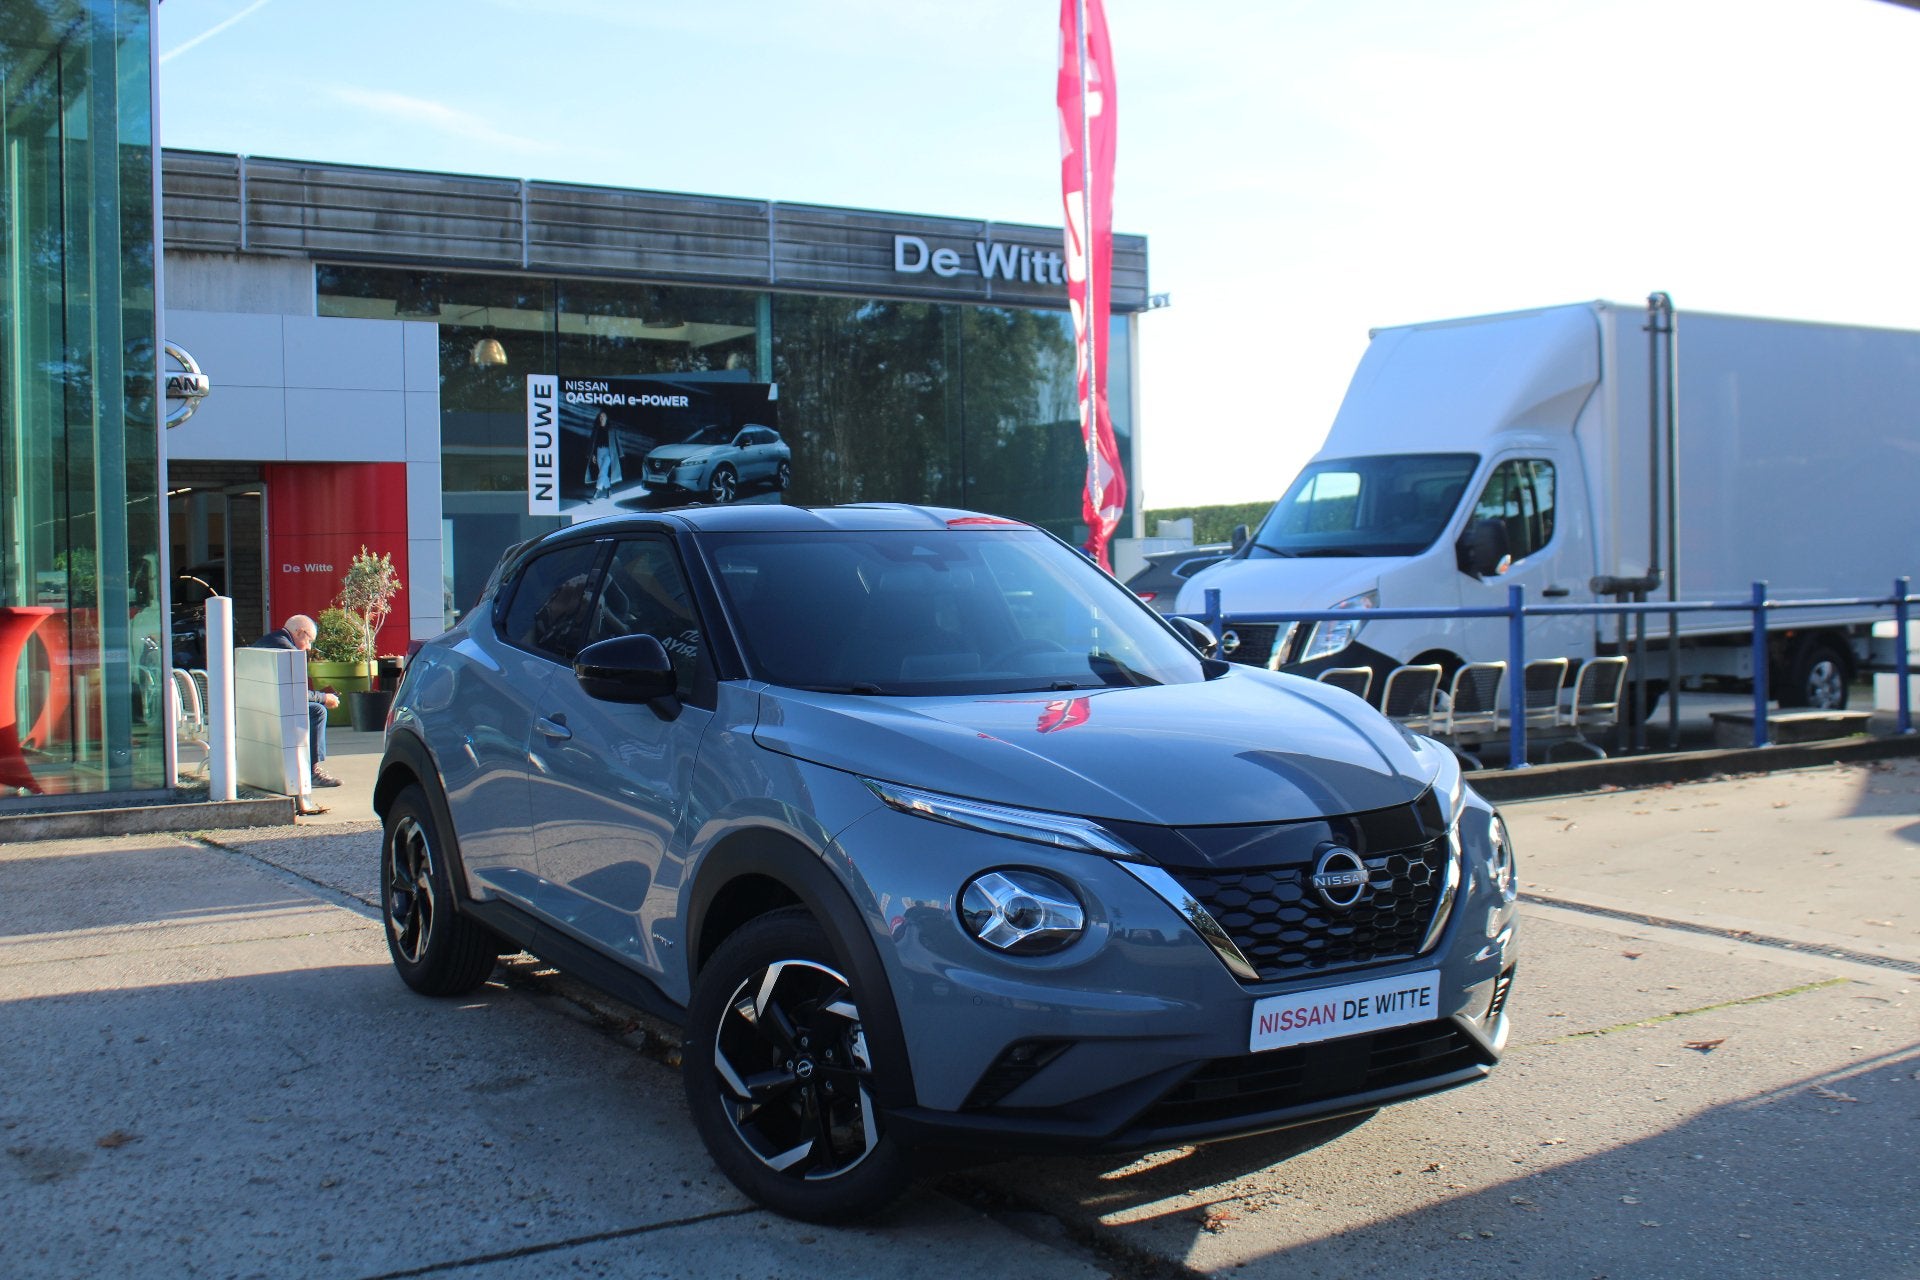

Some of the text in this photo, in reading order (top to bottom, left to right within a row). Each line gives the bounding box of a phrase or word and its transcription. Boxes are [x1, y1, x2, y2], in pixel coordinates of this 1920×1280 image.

[895, 235, 961, 277] De
[565, 380, 609, 392] NISSAN
[565, 392, 689, 407] QASHQAI e-POWER
[534, 383, 553, 501] NIEUWE
[282, 563, 334, 573] De Witte
[1314, 873, 1369, 887] NISSAN
[1259, 987, 1431, 1035] NISSAN DE WITTE
